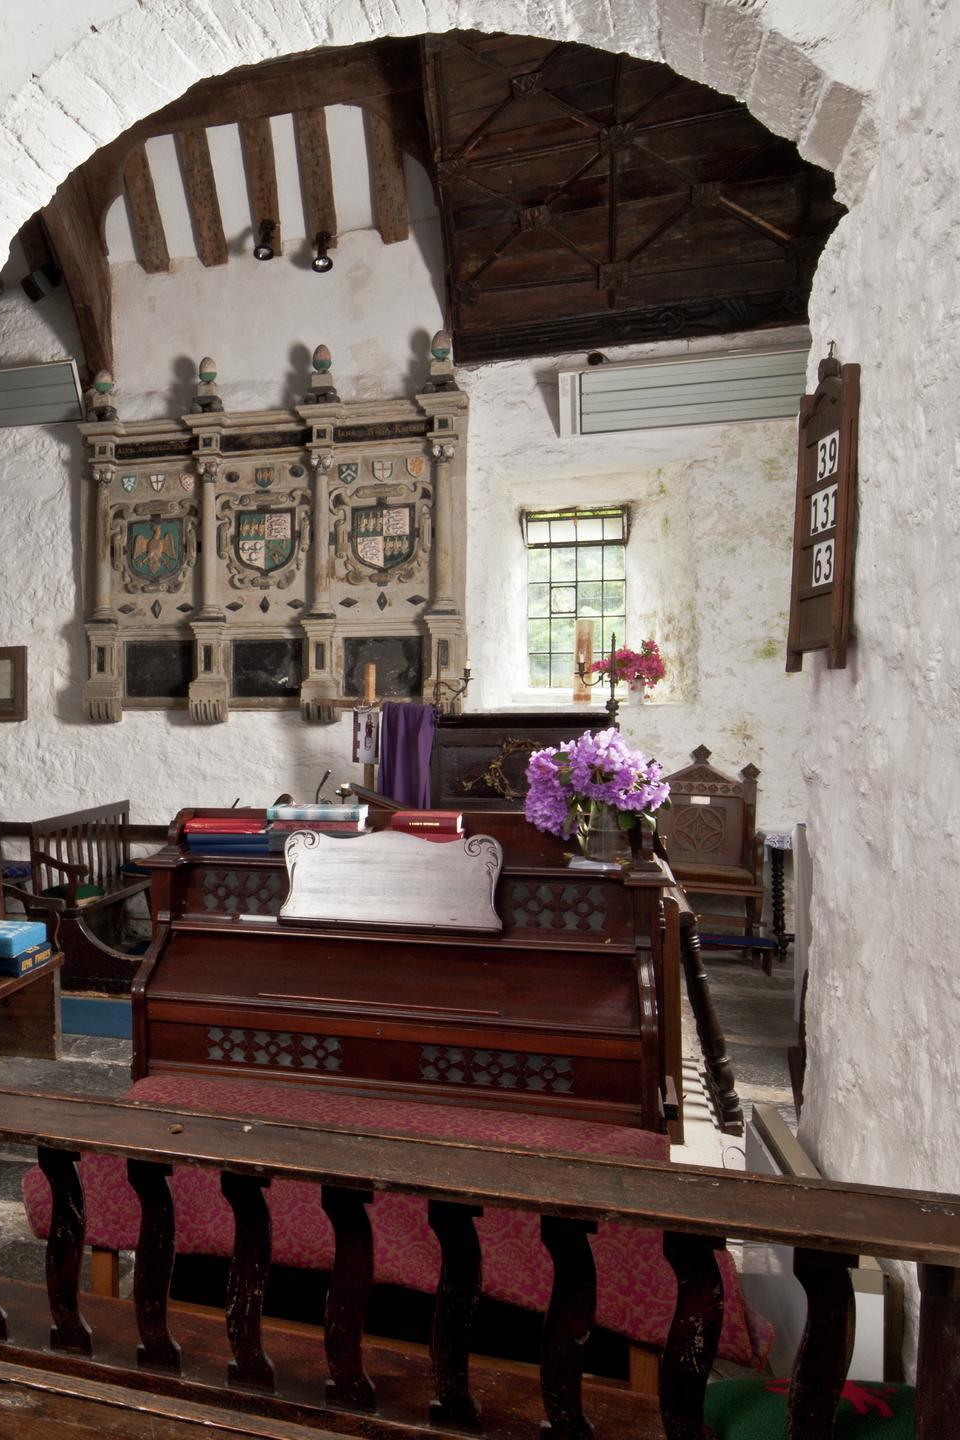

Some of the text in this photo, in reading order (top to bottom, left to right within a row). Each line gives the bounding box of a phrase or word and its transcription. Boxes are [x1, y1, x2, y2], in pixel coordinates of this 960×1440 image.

[819, 438, 836, 478] 39
[812, 490, 837, 533] 131
[815, 545, 832, 583] 63
